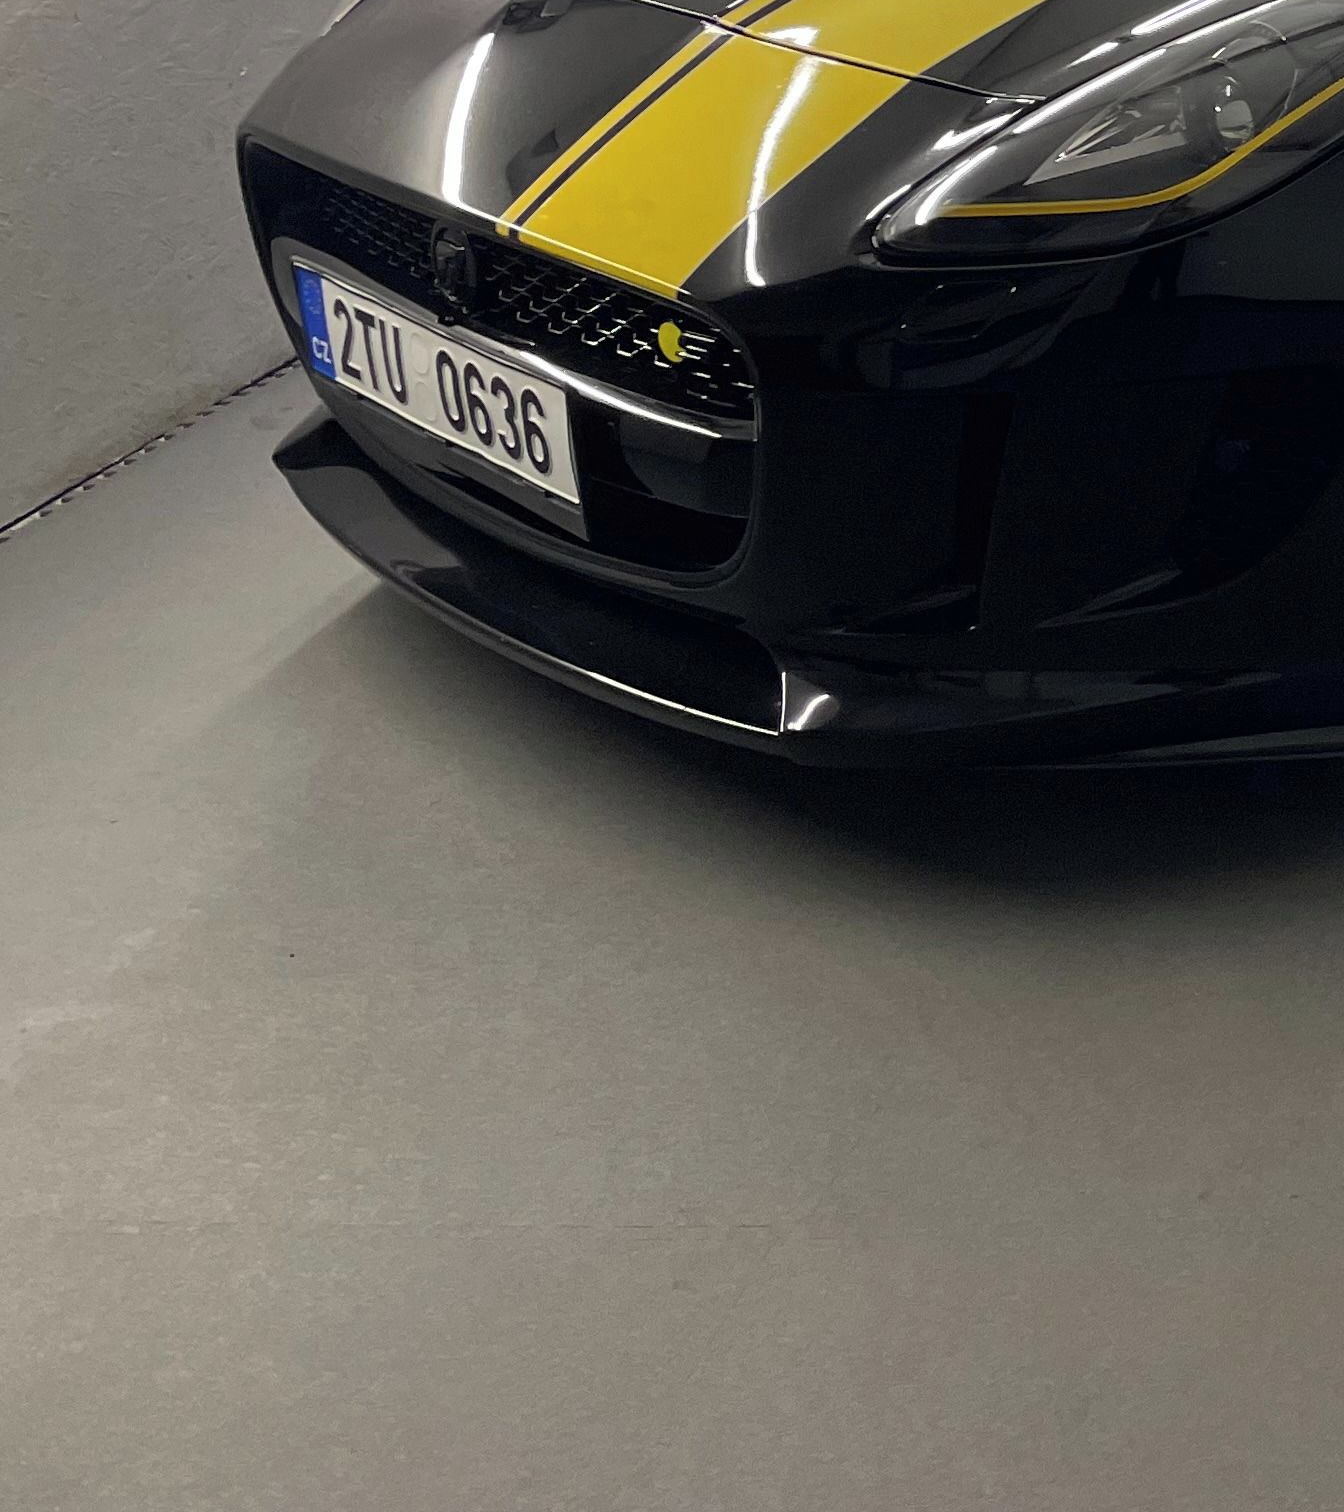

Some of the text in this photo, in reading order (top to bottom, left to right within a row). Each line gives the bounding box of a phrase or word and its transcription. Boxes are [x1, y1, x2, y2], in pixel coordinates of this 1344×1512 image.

[312, 336, 332, 364] CZ
[334, 298, 549, 474] 2TU 0636
